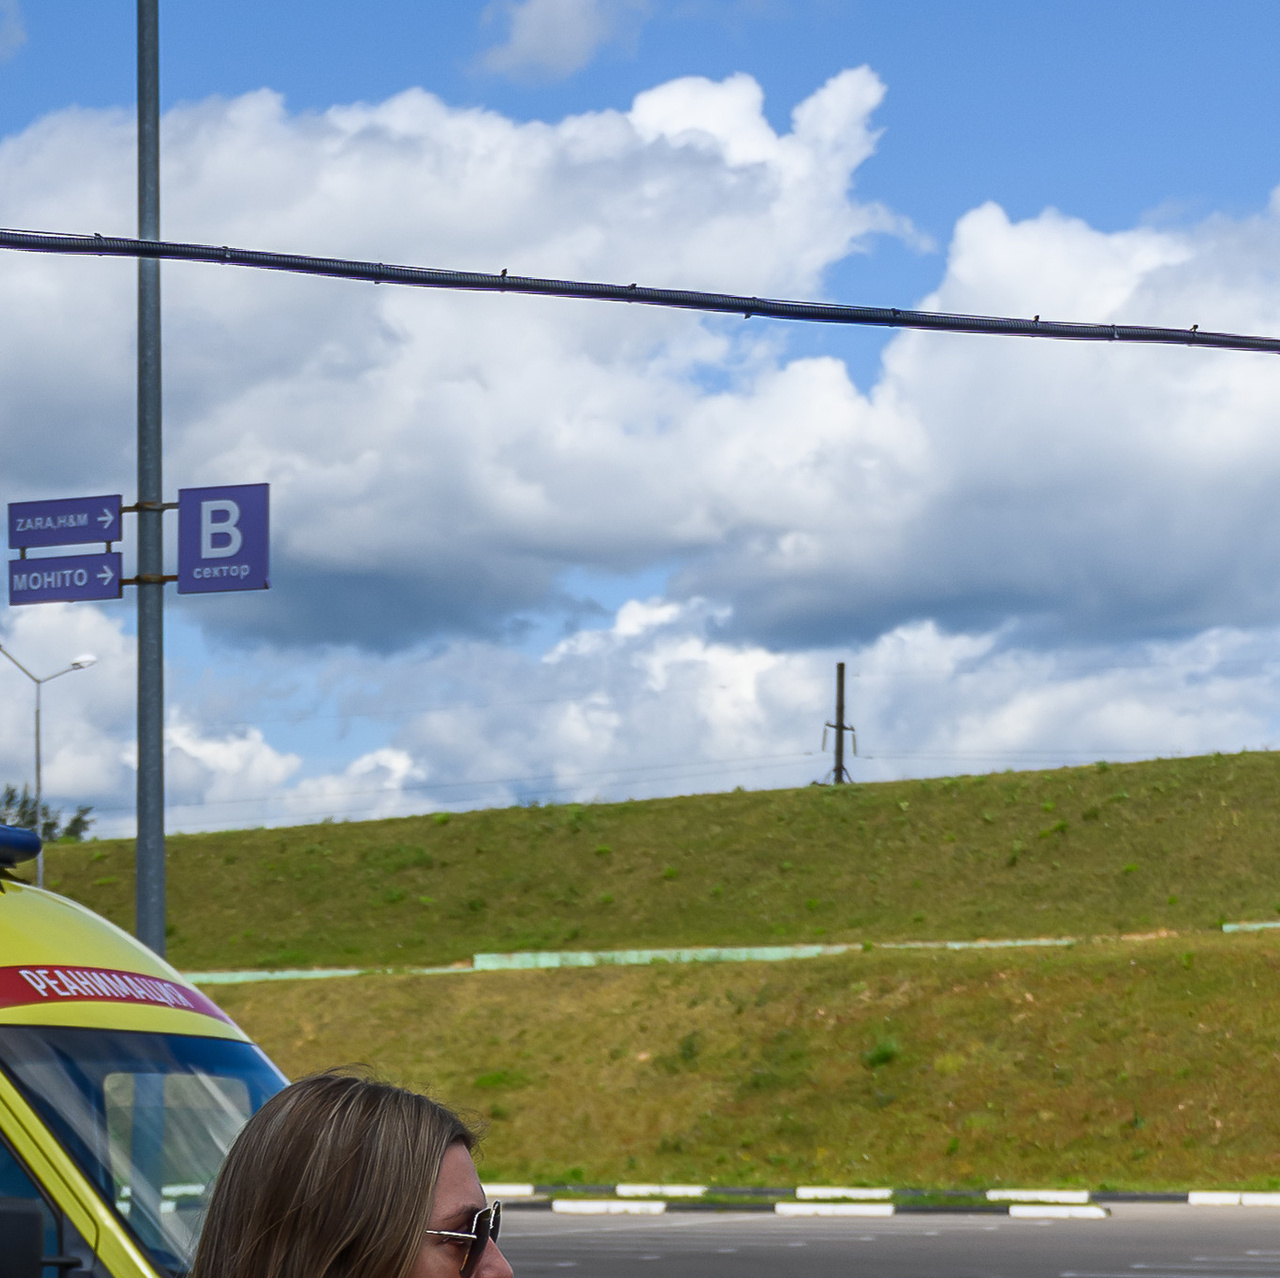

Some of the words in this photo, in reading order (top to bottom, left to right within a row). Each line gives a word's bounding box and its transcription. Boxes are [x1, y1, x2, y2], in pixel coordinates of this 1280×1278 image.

[15, 513, 89, 532] ZARA,H&M
[12, 568, 88, 592] MOHITO
[192, 564, 251, 580] сектор
[19, 969, 195, 1009] РЕАНИМАЦИЯ
